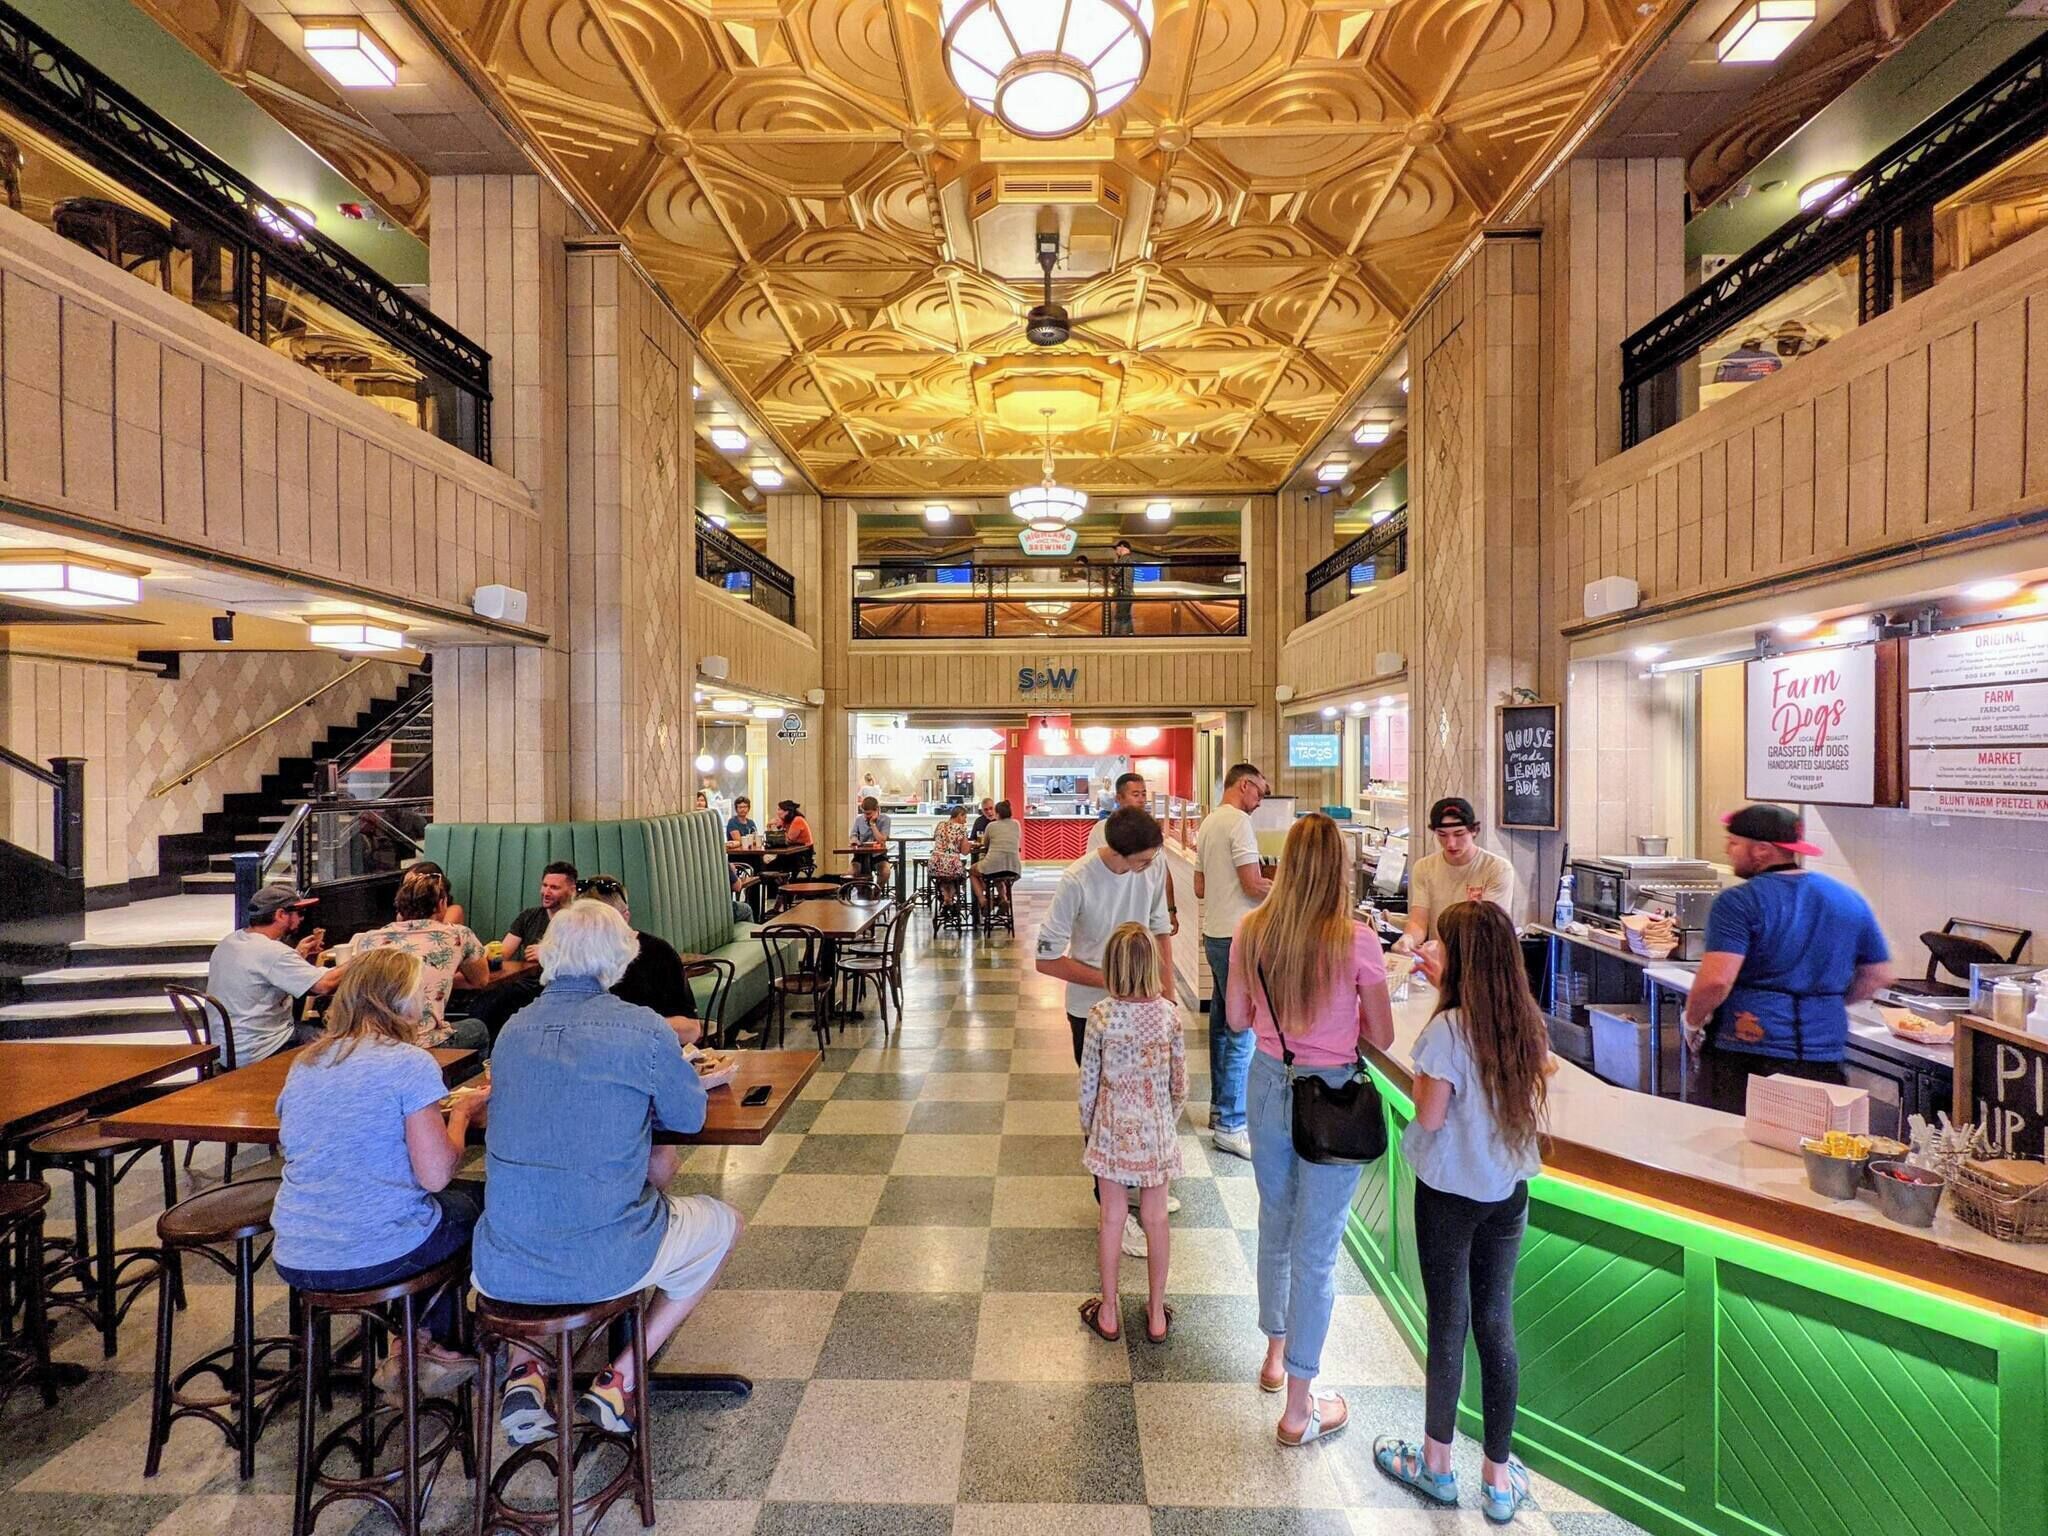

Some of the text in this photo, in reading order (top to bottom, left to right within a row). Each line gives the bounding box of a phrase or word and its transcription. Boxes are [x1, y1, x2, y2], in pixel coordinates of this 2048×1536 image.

[1029, 543, 1067, 551] BREWING
[1975, 630, 2027, 648] ORIGINAL
[1018, 667, 1078, 689] S&W
[1772, 668, 1841, 708] Farm
[1984, 689, 2014, 704] FARM
[1772, 699, 1847, 751] Dogs
[1971, 724, 2030, 733] FARM SAUSAGE
[1505, 727, 1554, 751] HOUSE
[1295, 746, 1332, 761] TACOS
[1510, 749, 1544, 761] made
[1768, 744, 1849, 757] GRASSFED HOT DOGS
[1768, 760, 1849, 770] HANDCRAFTED SAUSAGES
[1978, 752, 2022, 765] MARKET
[1505, 761, 1551, 782] LEMON
[1939, 795, 1965, 806] BLUNT
[1967, 796, 1993, 807] WARM
[1995, 797, 2034, 809] PRETZEL
[1980, 1099, 2026, 1160] UP
